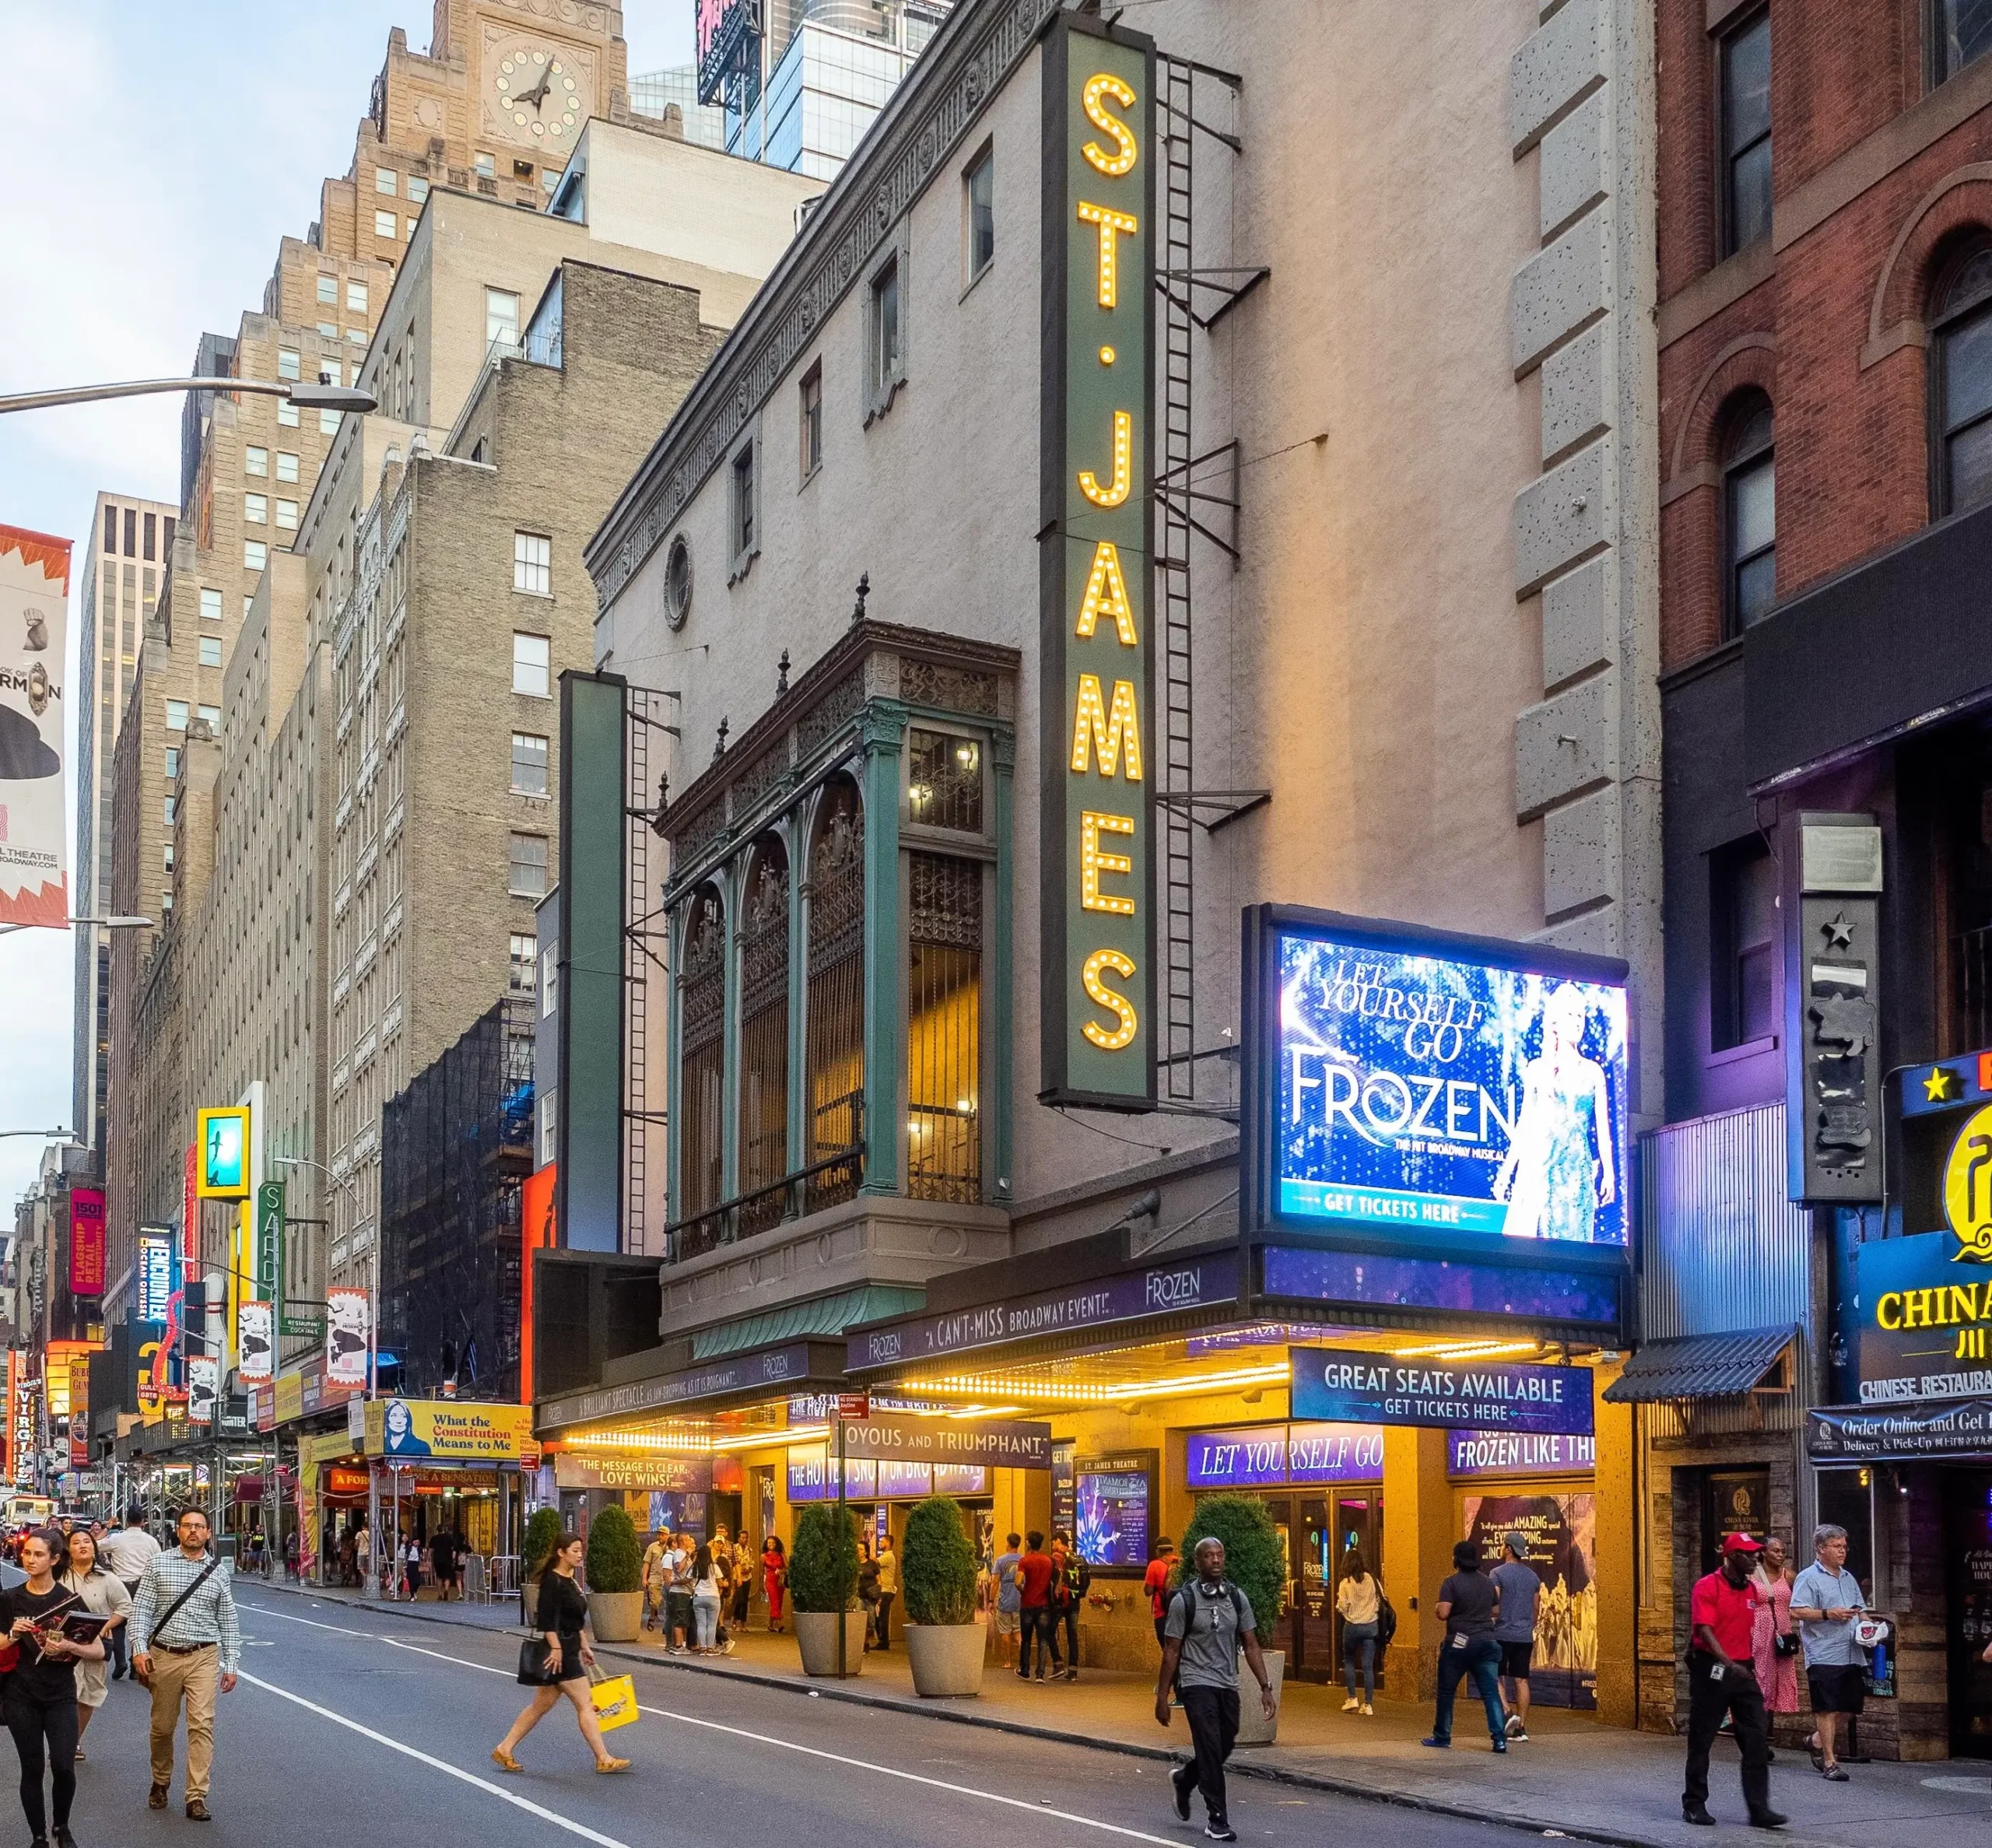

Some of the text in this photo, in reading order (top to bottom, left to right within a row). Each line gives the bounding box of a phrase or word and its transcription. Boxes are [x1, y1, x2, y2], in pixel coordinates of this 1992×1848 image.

[0, 666, 27, 678] OK OF
[1071, 411, 1142, 1050] JAMES
[7, 848, 58, 862] THEATRE
[1333, 959, 1388, 987] LET
[1318, 977, 1488, 1031] YOURSELF
[1404, 1021, 1464, 1063] GO
[1290, 1043, 1516, 1148] FROZEN
[1395, 1138, 1411, 1152] THE
[1427, 1141, 1471, 1157] BROADWAY
[1471, 1147, 1506, 1162] MUSICAL
[75, 1201, 102, 1215] 1501
[1324, 1192, 1460, 1223] GET TICKETS HERE
[75, 1222, 86, 1282] FLAGSHIP
[85, 1243, 95, 1283] RETAIL
[139, 1247, 148, 1278] OCEAN
[1146, 1268, 1200, 1308] FROZEN
[938, 1306, 1004, 1347] CAN'T-MISS
[1010, 1302, 1065, 1332] BROADWAY
[868, 1331, 901, 1362] FROZEN
[763, 1354, 788, 1379] FROZEN
[1324, 1364, 1562, 1403] GREAT SEATS AVAILABLE
[1860, 1376, 1917, 1400] CHINESE
[584, 1392, 612, 1415] BRILLIANT
[688, 1383, 693, 1394] AS
[695, 1378, 700, 1393] IT
[701, 1379, 706, 1391] IS
[1385, 1397, 1507, 1421] GET TICKETS HERE
[433, 1414, 490, 1427] What the
[433, 1425, 511, 1439] Constitution
[1842, 1411, 1983, 1436] Order Online and Get
[433, 1439, 511, 1450] Means to Me
[835, 1426, 1047, 1454] OYOUS AND TRIUMPHANT."
[1457, 1437, 1519, 1468] FROZEN
[1524, 1436, 1560, 1464] LIKE
[1843, 1437, 1932, 1451] Delivery & Pick-Up
[1053, 1451, 1063, 1464] GET
[1085, 1462, 1093, 1471] ST.
[1113, 1460, 1138, 1468] THEATRE
[1200, 1433, 1384, 1475] LET YOURSELF GO
[441, 1473, 496, 1482] SENSATION
[578, 1459, 688, 1475] "THE MESSAGE IS CLEAR:
[600, 1471, 633, 1485] LOVE
[789, 1465, 805, 1487] "THE
[806, 1458, 850, 1485] HOTTET
[854, 1459, 888, 1482] SNOW
[336, 1475, 370, 1485] A FOR
[1514, 1516, 1547, 1529] AMAZING
